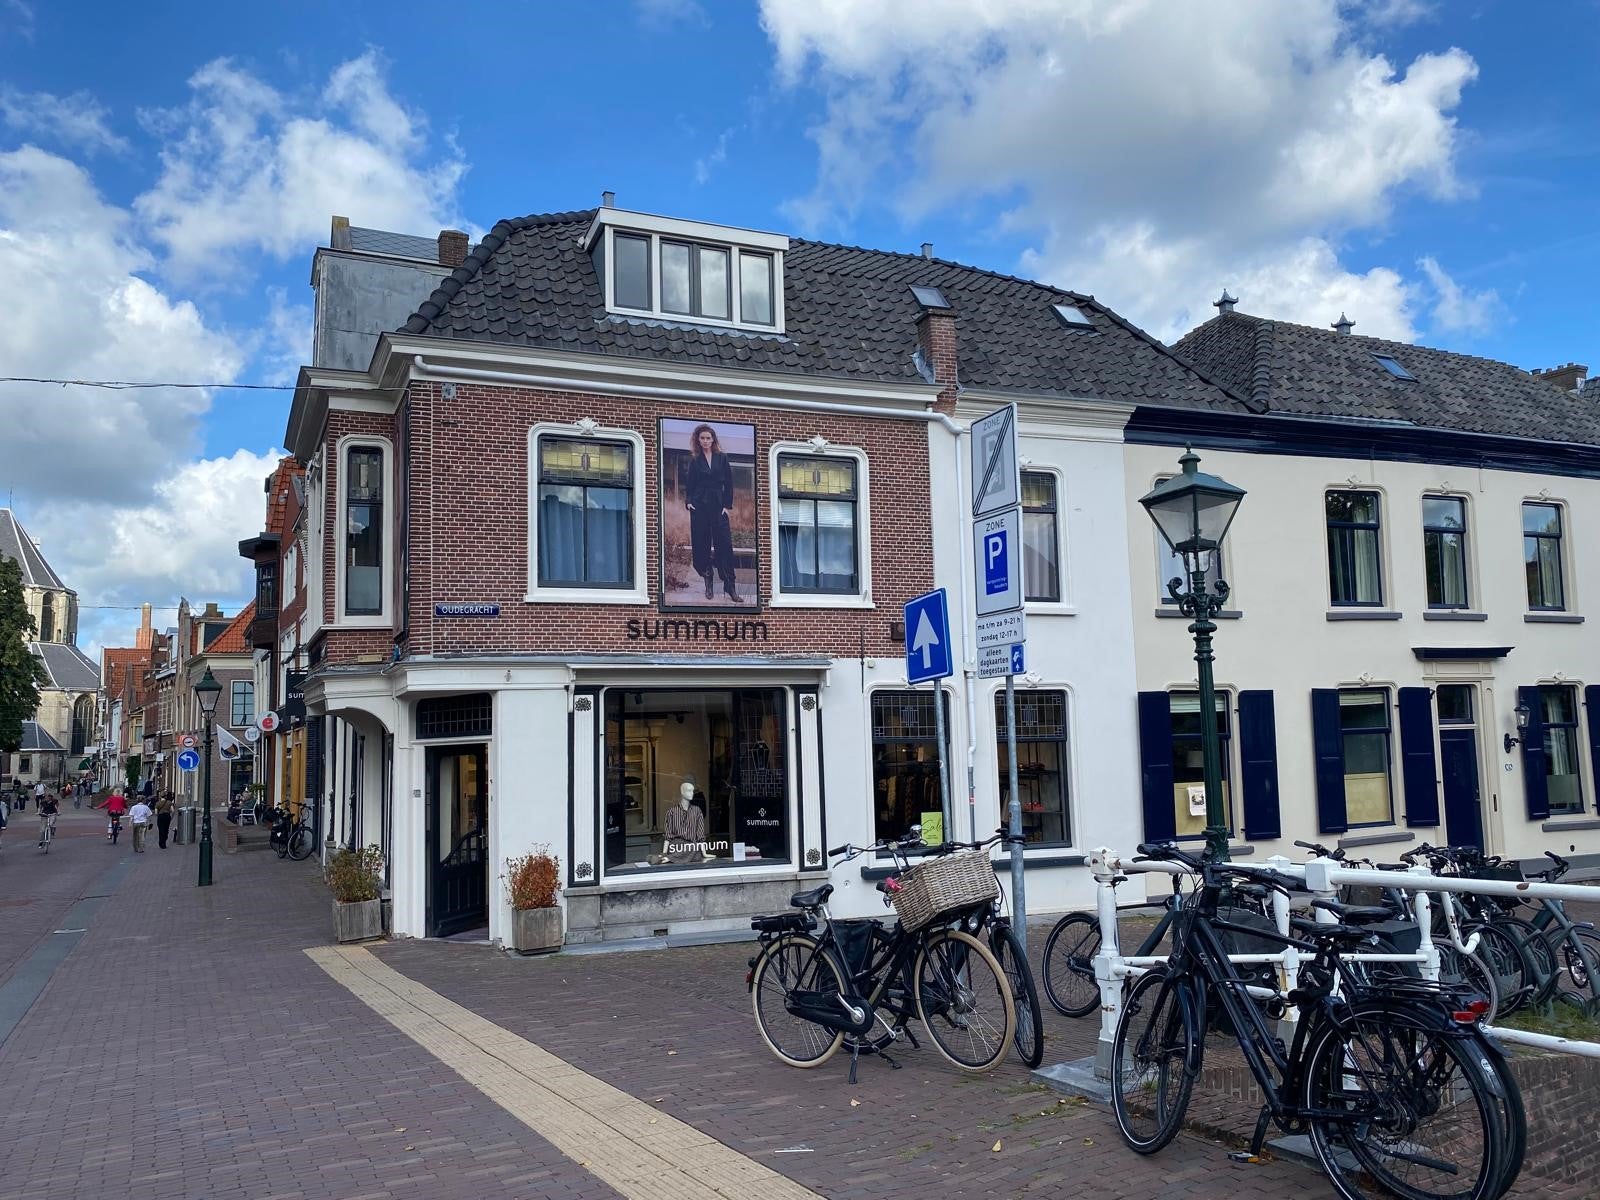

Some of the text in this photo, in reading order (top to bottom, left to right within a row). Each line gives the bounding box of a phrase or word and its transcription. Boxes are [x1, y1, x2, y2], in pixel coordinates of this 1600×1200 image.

[983, 416, 1001, 431] ZONE
[986, 518, 1005, 532] ZONE
[988, 536, 1003, 570] P
[441, 605, 494, 614] OUDEGRACHT
[1004, 617, 1016, 626] 9-21
[627, 619, 767, 641] summum
[999, 630, 1013, 639] 12-17
[980, 657, 1009, 667] dagkaarten
[980, 666, 1009, 676] toegestaan
[746, 818, 780, 827] summum
[669, 840, 729, 853] summum
